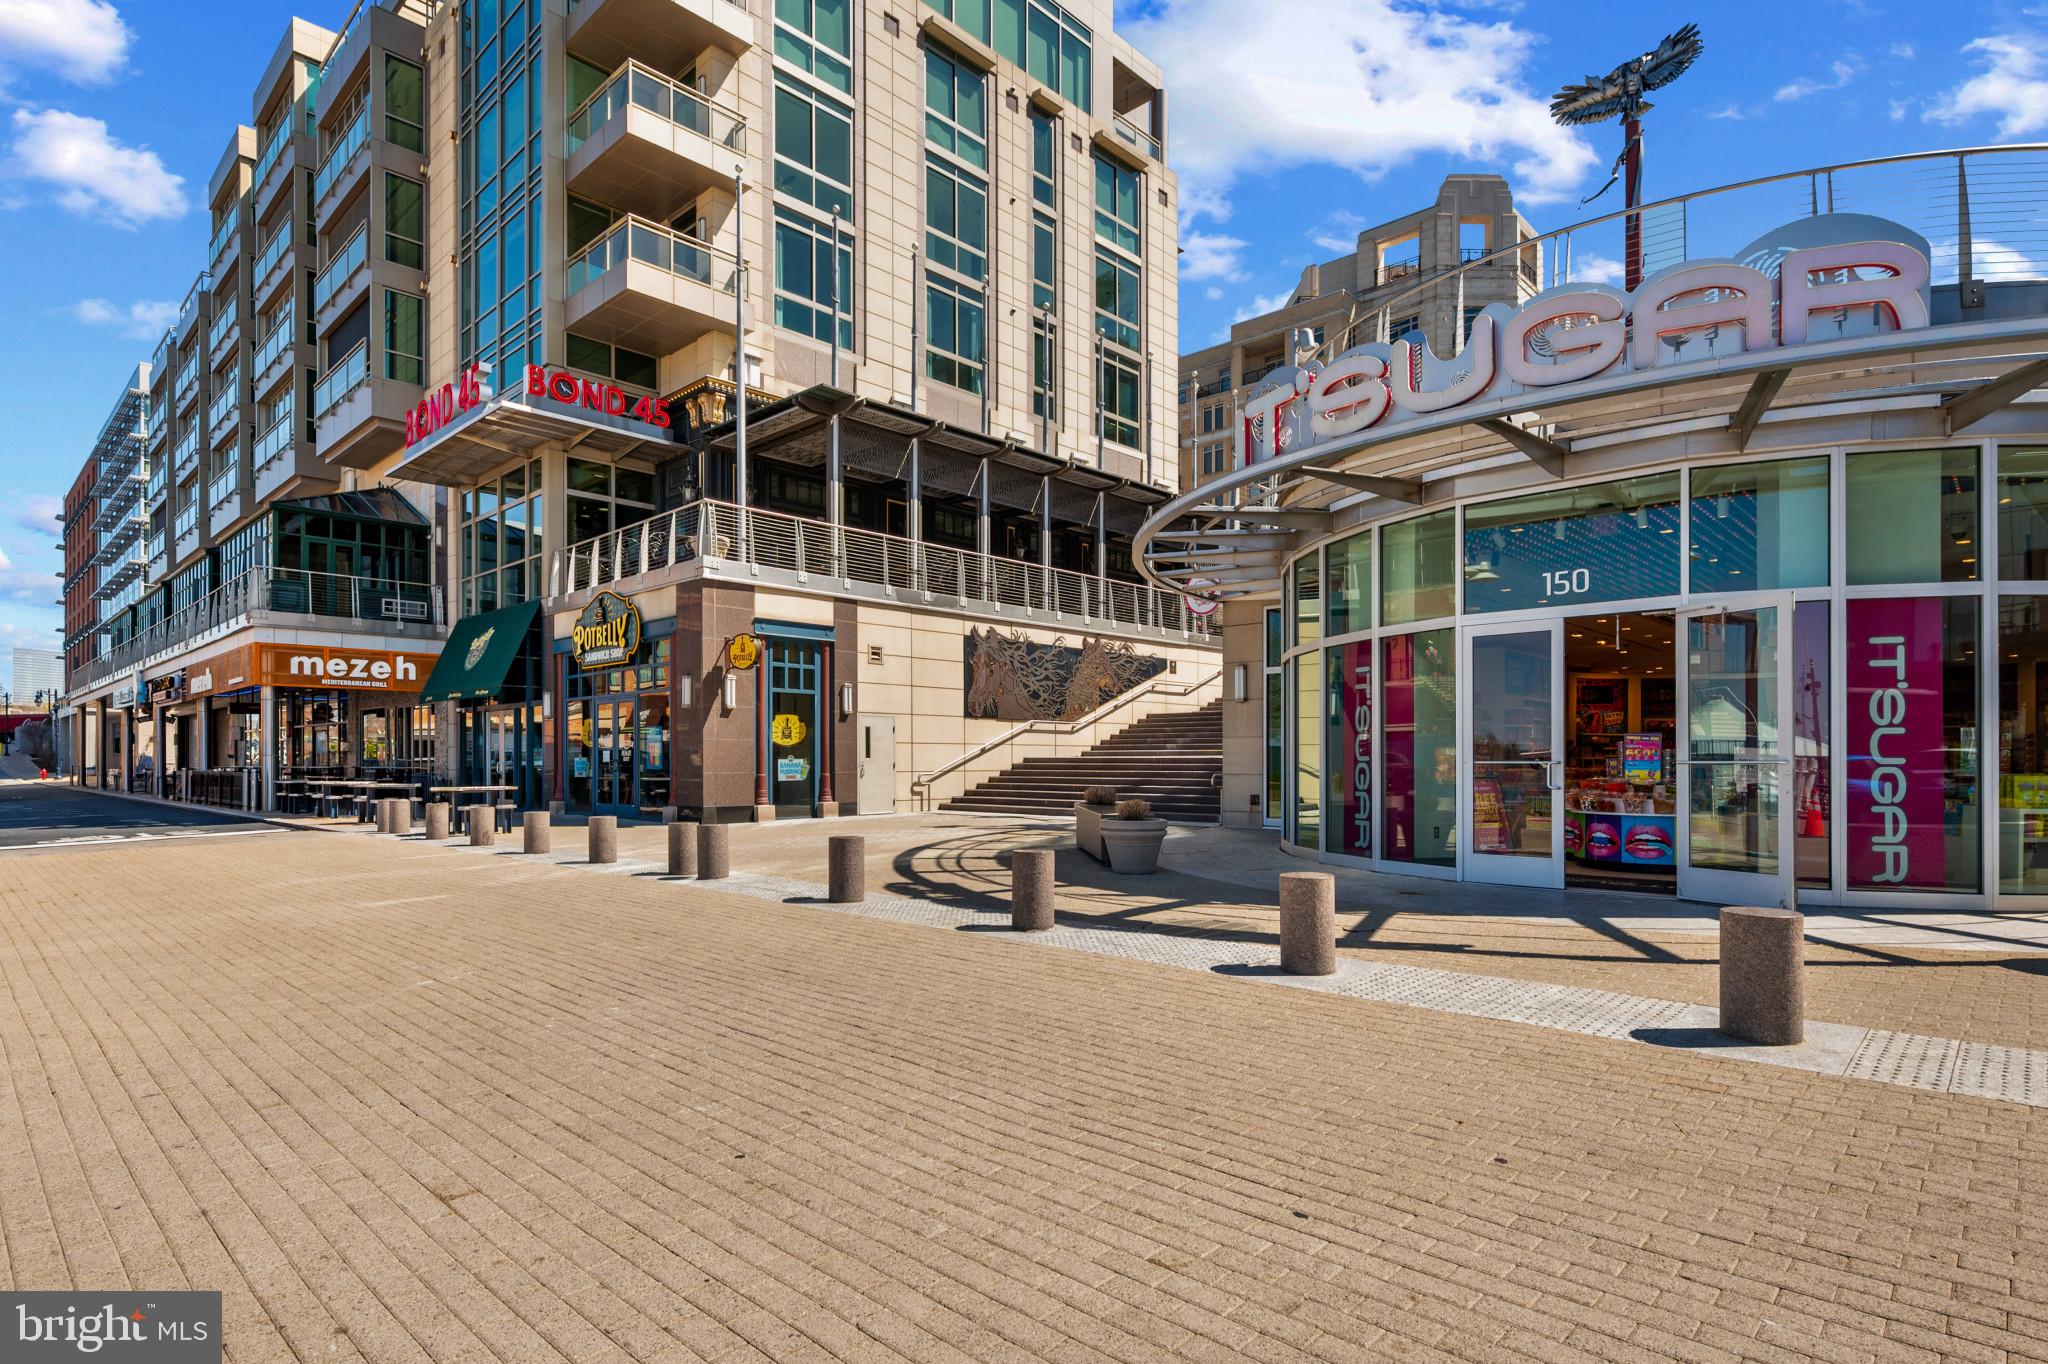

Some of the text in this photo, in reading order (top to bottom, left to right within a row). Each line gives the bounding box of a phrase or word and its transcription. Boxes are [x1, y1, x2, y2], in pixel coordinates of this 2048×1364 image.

[1235, 241, 1930, 470] IT'SUGAR
[404, 361, 489, 449] BOND 45
[526, 362, 672, 429] BOND 45
[1541, 568, 1591, 597] 150
[289, 655, 417, 681] mezeh
[573, 612, 628, 657] POTBELLY
[321, 678, 389, 688] MEDITERRANEAN GRILL
[1354, 665, 1371, 849] IT'SUGAR
[1868, 635, 1909, 883] IT'SUGAR
